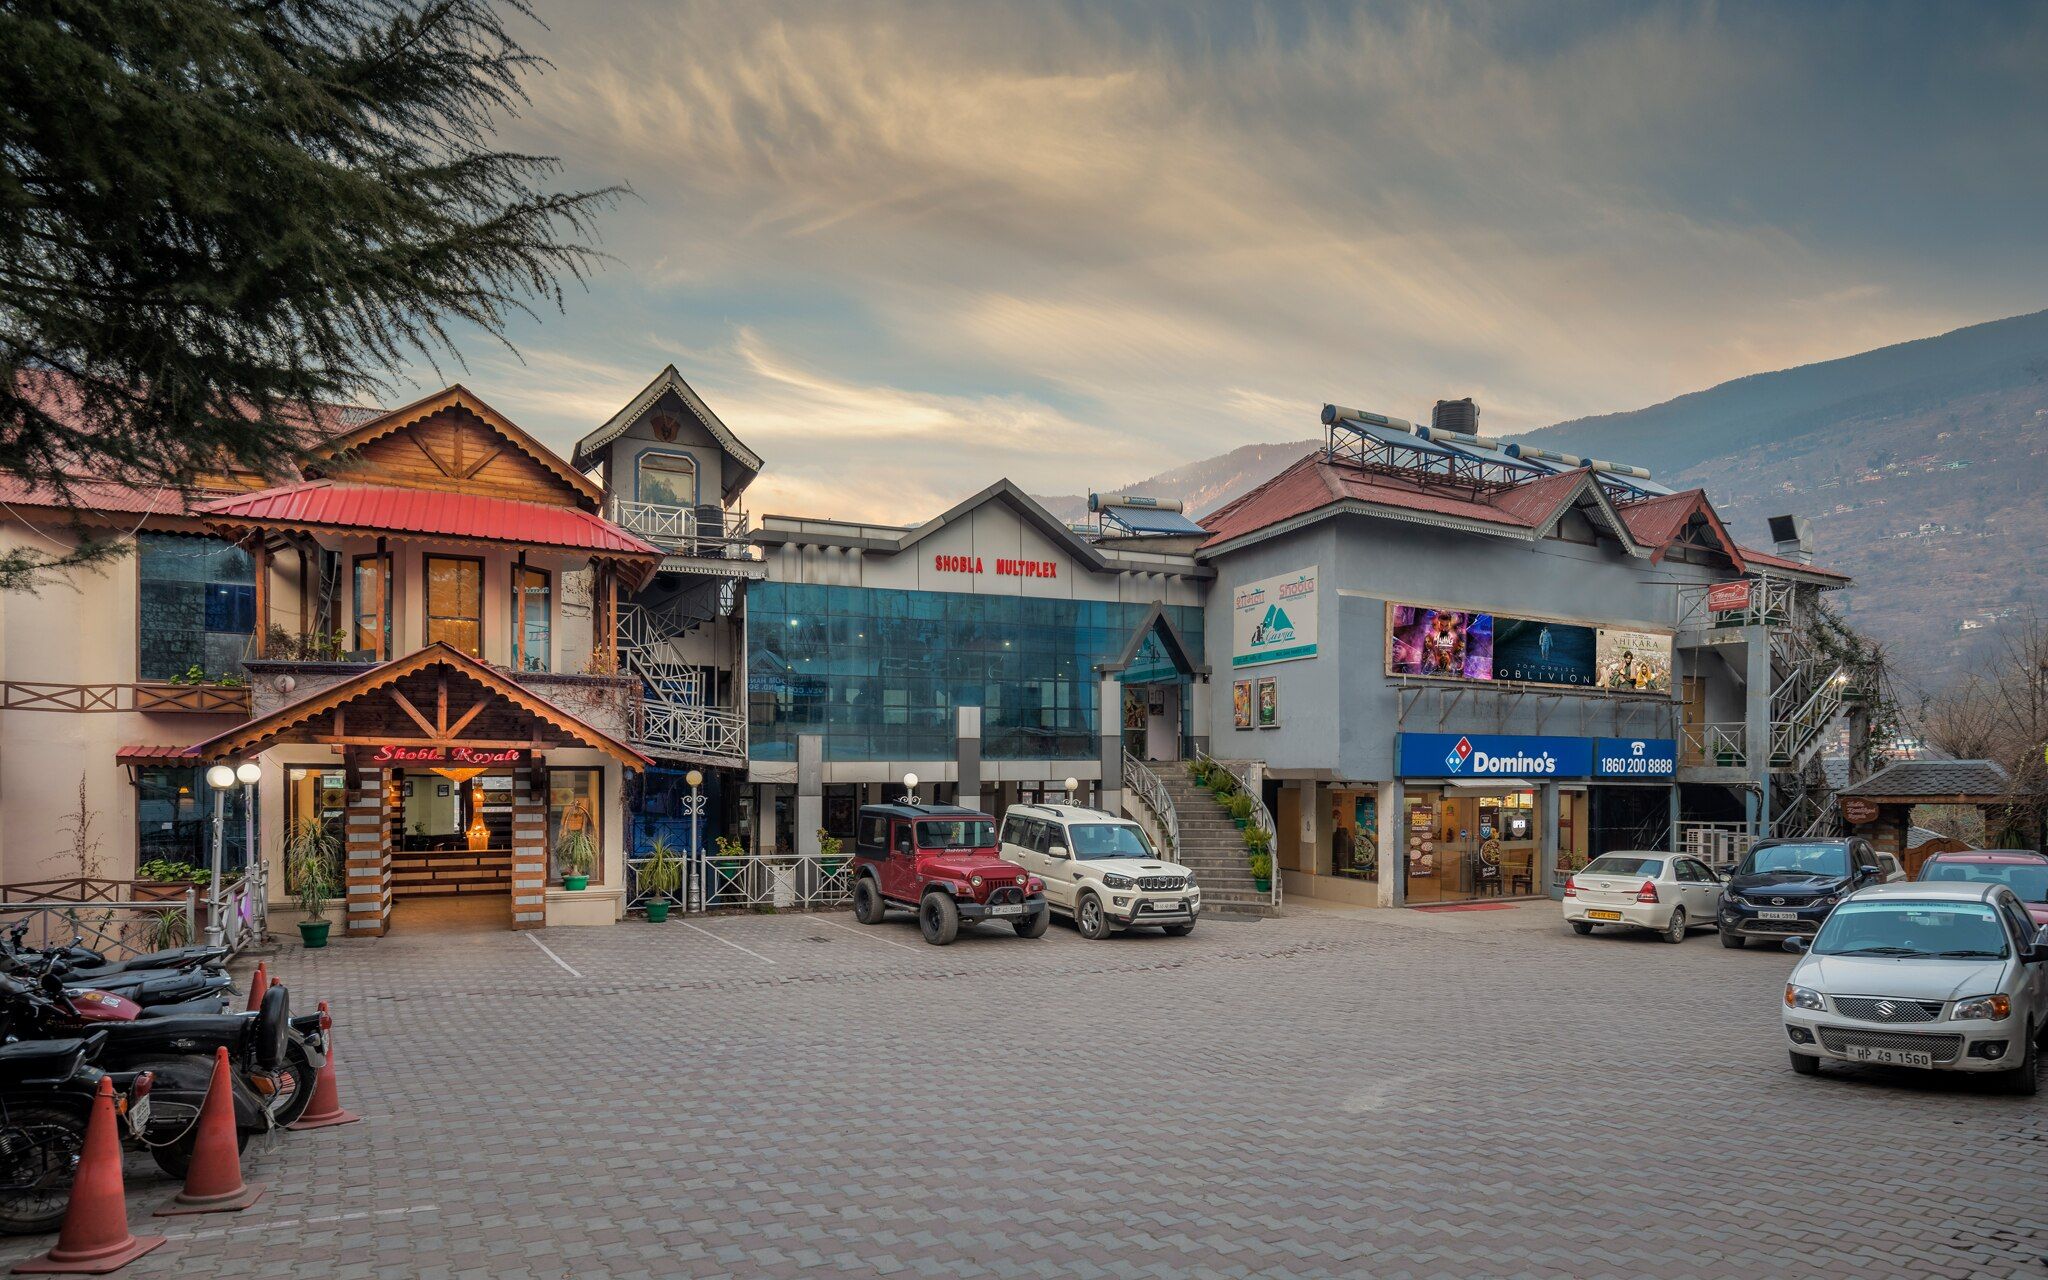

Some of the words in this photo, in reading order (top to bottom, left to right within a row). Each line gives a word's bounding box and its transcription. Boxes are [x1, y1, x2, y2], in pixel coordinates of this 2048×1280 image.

[935, 554, 984, 574] SHOBLA
[996, 558, 1057, 578] MULTIPLEX
[1613, 638, 1659, 648] SHIKARA
[1500, 669, 1590, 683] OBLIVION
[452, 746, 521, 764] Royale
[1473, 751, 1556, 773] Domino's
[1601, 757, 1626, 773] 1860
[1627, 758, 1646, 773] 200
[1648, 759, 1673, 774] 8888
[1857, 1049, 1872, 1060] HP
[1898, 1052, 1928, 1065] 1560
